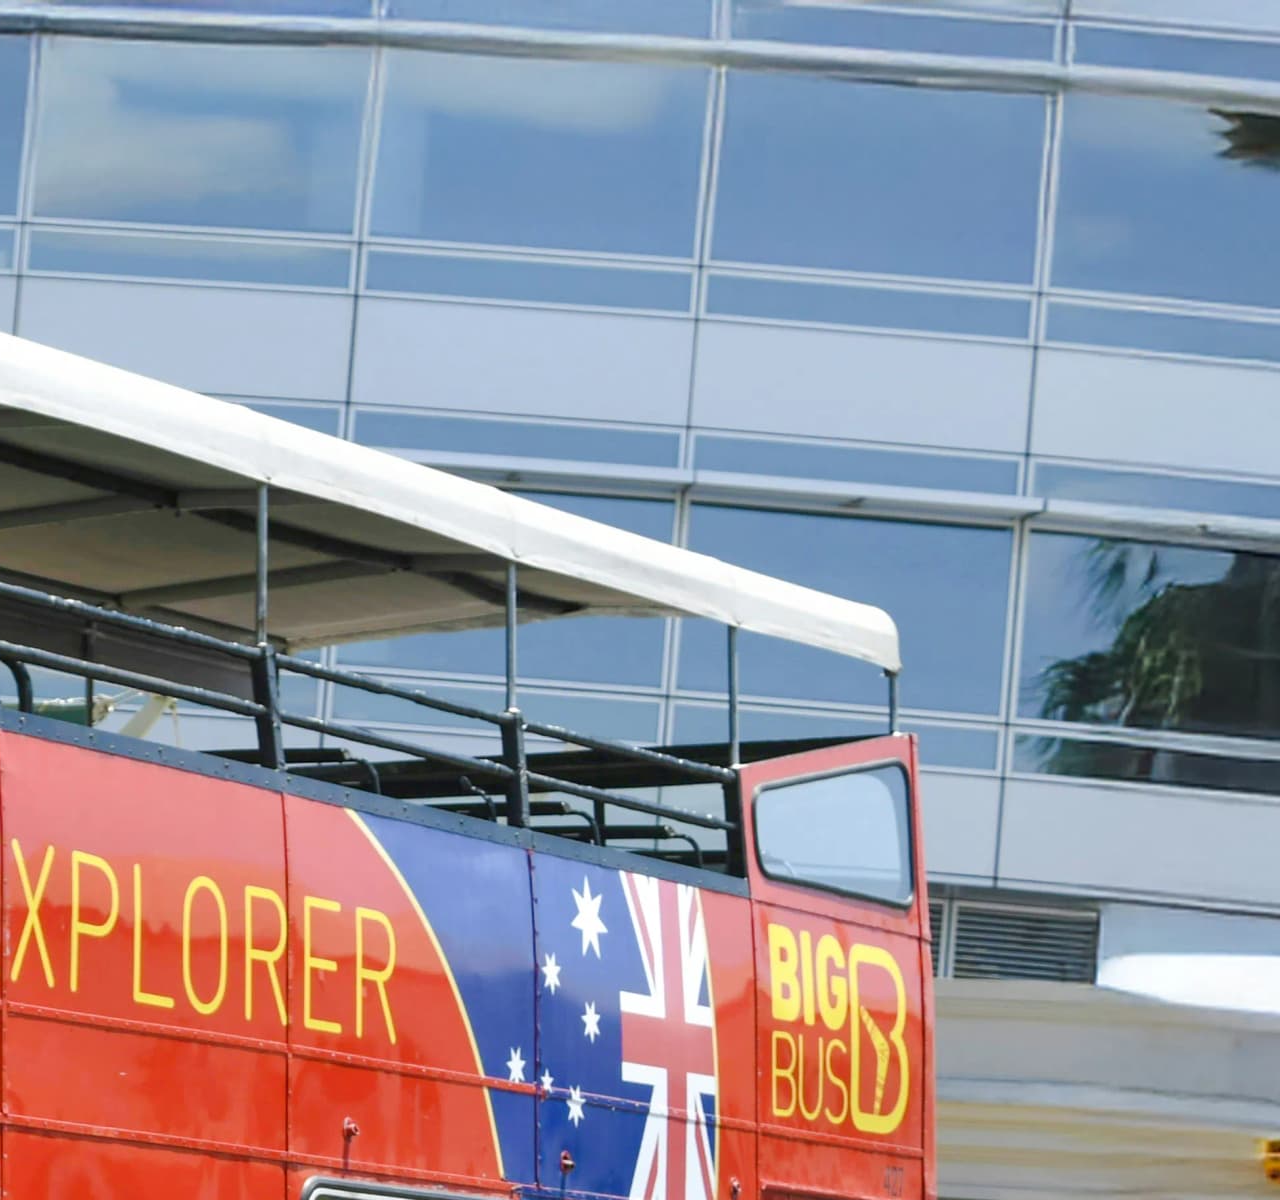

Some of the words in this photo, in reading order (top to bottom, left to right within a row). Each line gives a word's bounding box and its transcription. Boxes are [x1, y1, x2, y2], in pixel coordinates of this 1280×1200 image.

[768, 923, 848, 1031] BIG
[772, 1030, 848, 1125] BUS
[884, 1165, 904, 1197] 427
